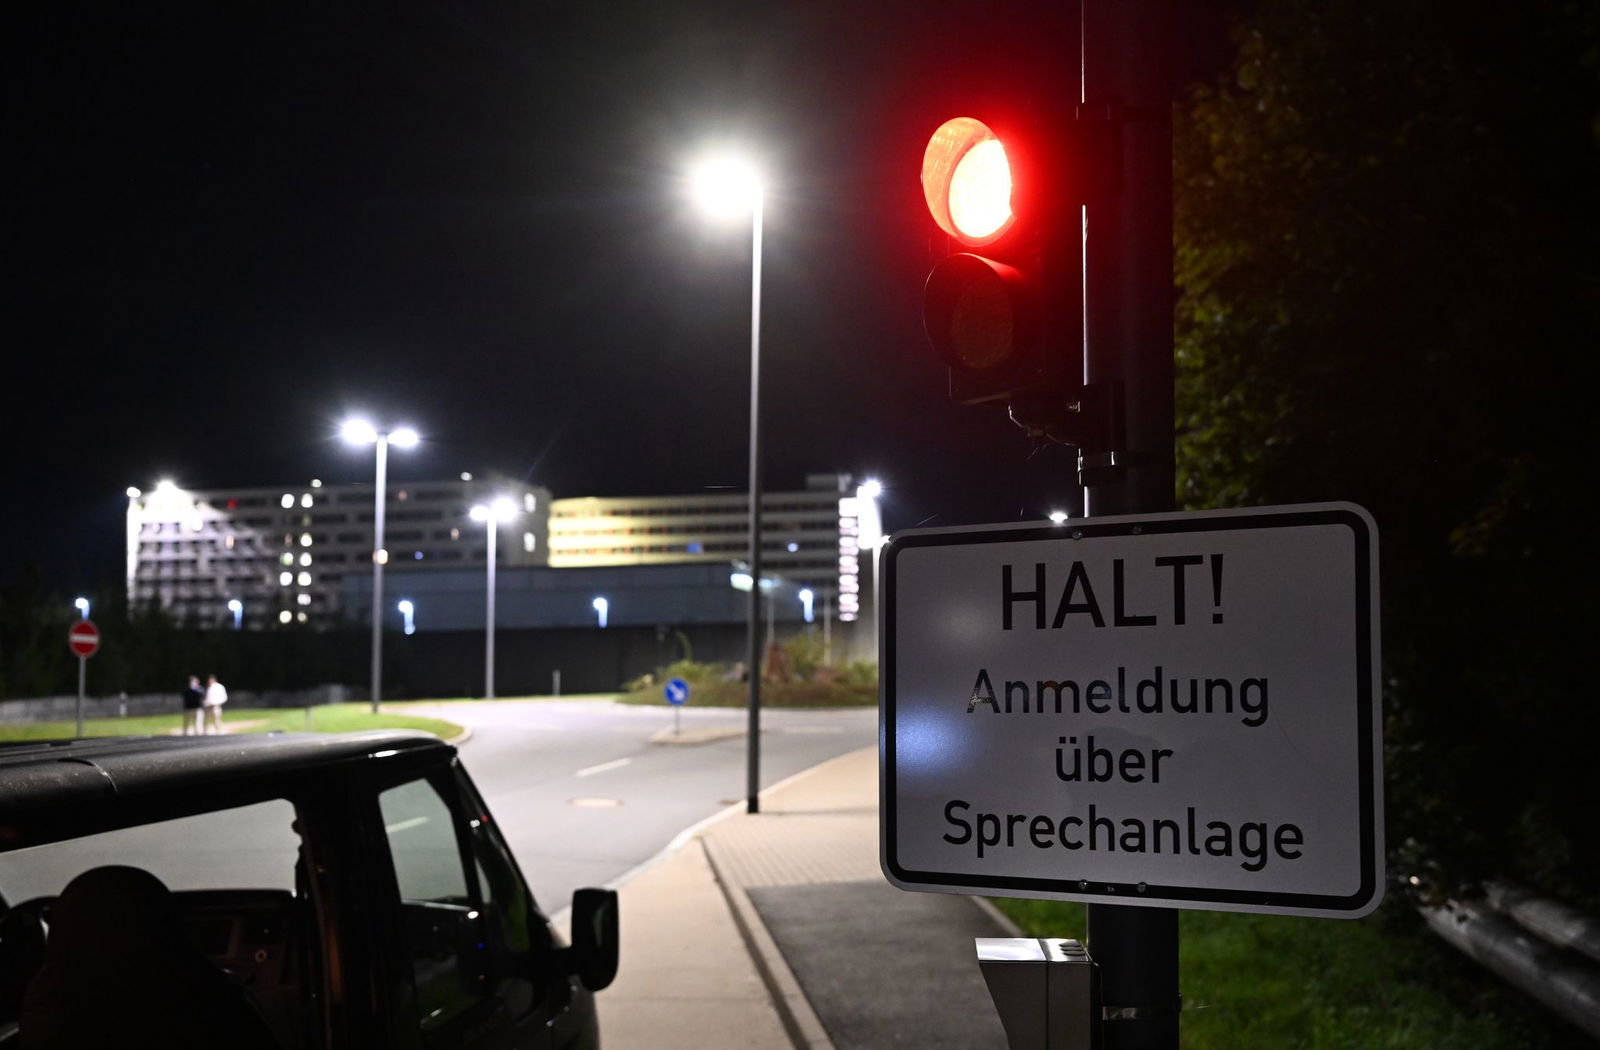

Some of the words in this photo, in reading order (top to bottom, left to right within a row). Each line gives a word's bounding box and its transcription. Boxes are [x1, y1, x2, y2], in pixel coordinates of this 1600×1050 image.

[1002, 554, 1224, 631] HALT!
[966, 666, 1269, 727] Anmeldung
[1055, 735, 1174, 783] über
[942, 799, 1304, 872] Sprechanlage
